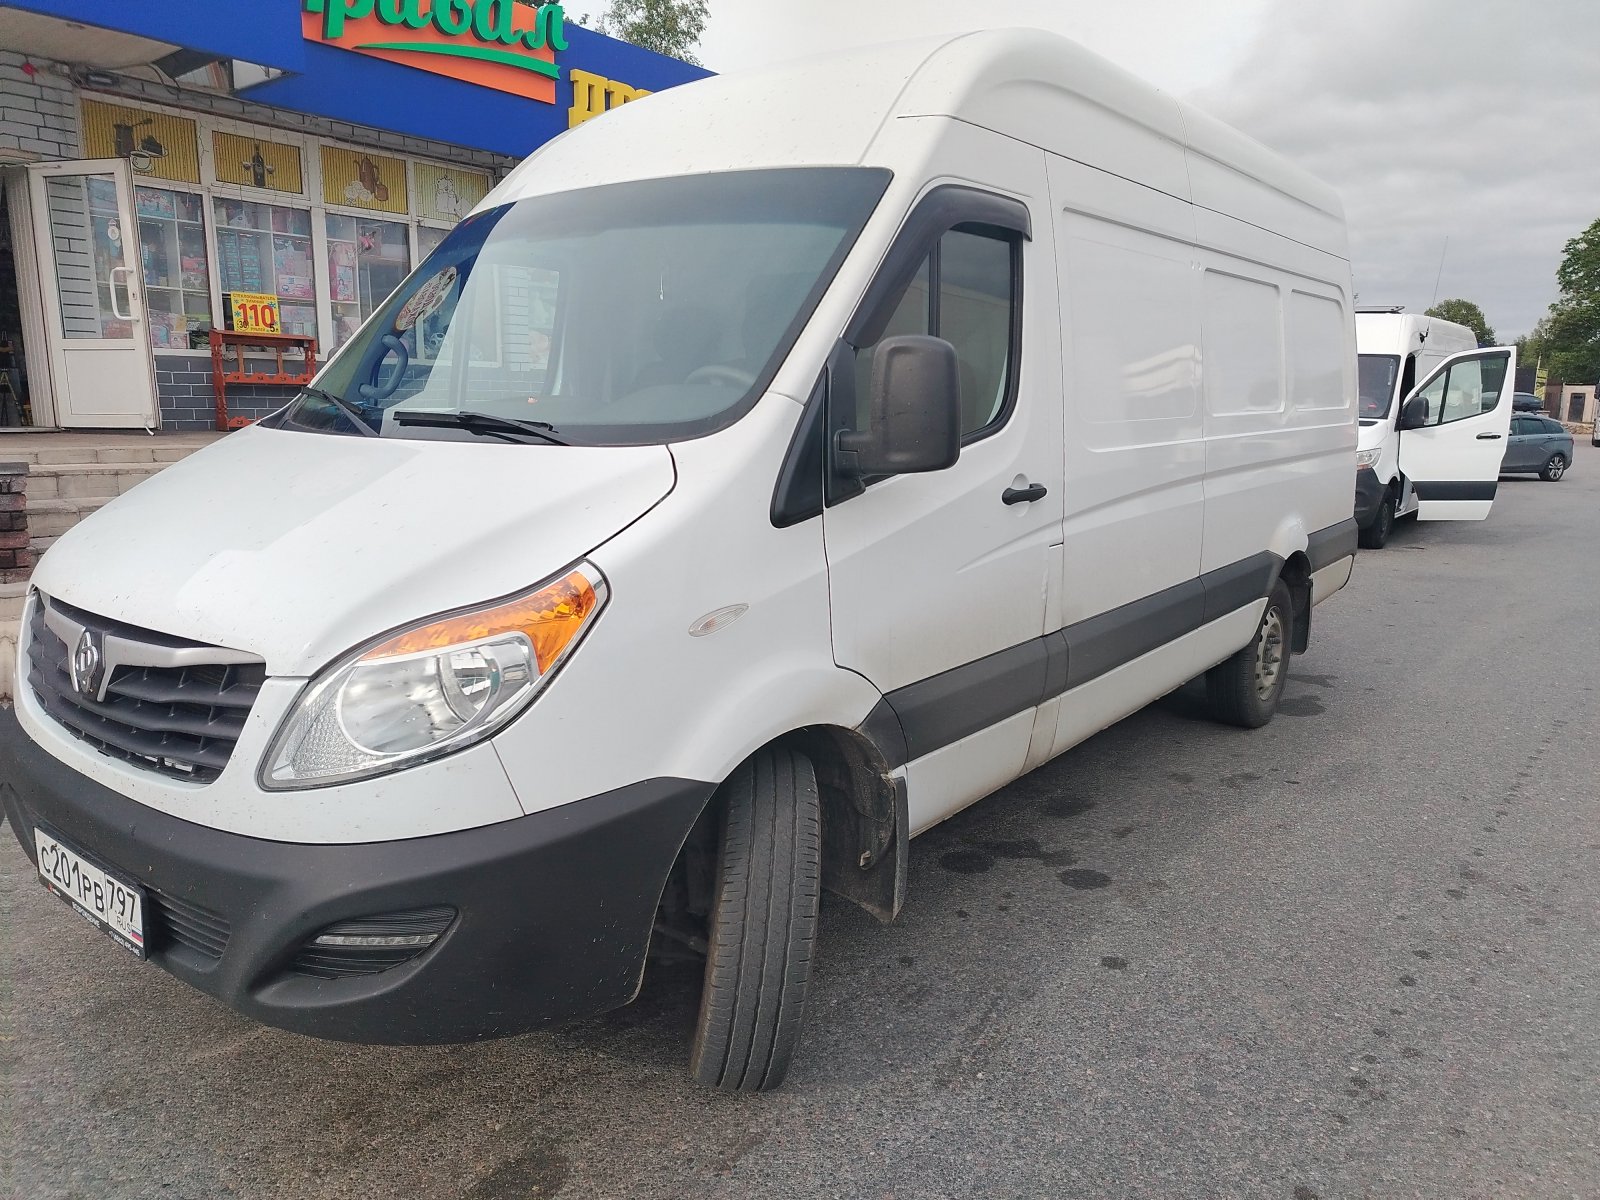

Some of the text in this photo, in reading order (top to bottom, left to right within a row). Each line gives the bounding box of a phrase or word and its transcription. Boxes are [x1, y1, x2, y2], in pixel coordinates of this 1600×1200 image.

[238, 303, 276, 328] 110
[106, 878, 137, 922] 797
[116, 914, 132, 934] RUS
